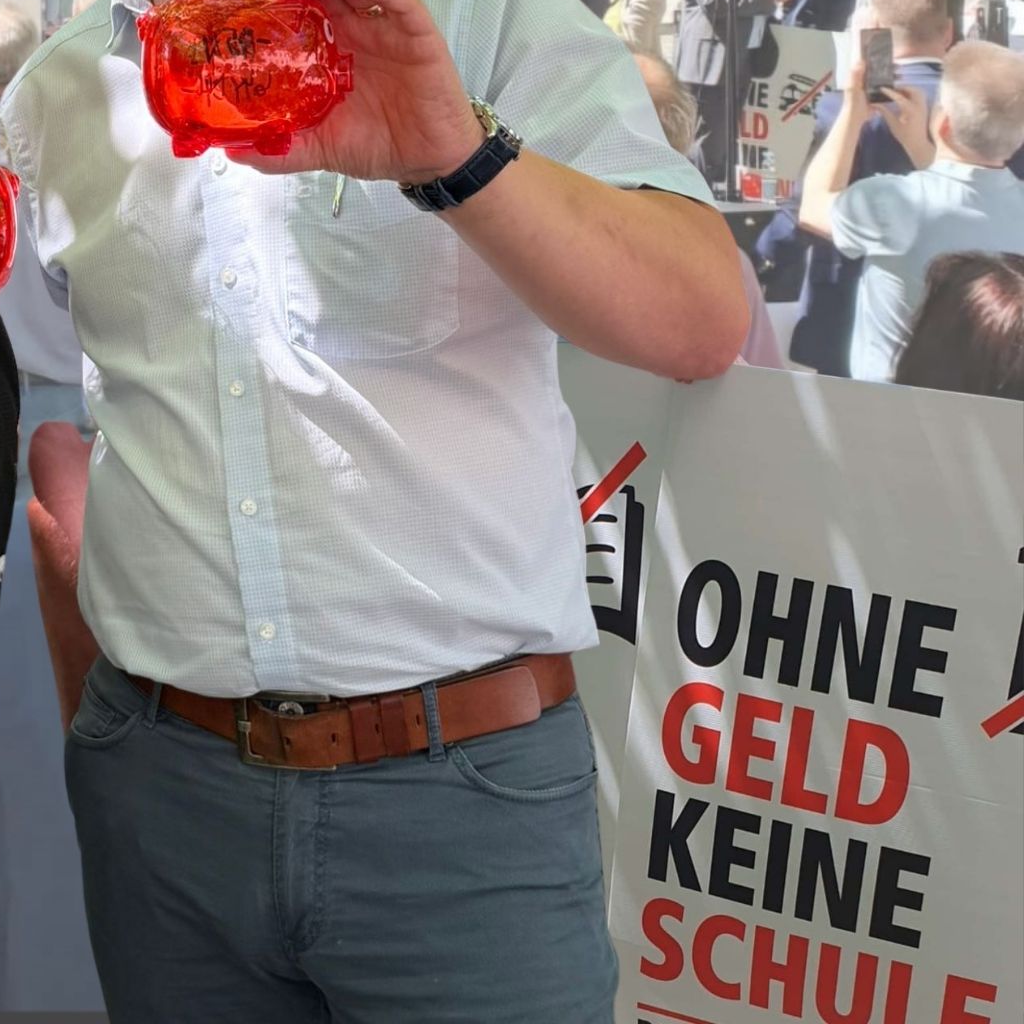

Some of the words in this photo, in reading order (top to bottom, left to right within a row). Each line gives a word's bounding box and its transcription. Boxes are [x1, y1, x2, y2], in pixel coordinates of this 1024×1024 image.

[739, 111, 769, 140] LD
[676, 559, 958, 719] OHNE
[661, 681, 910, 825] GELD
[647, 789, 932, 949] KEINE
